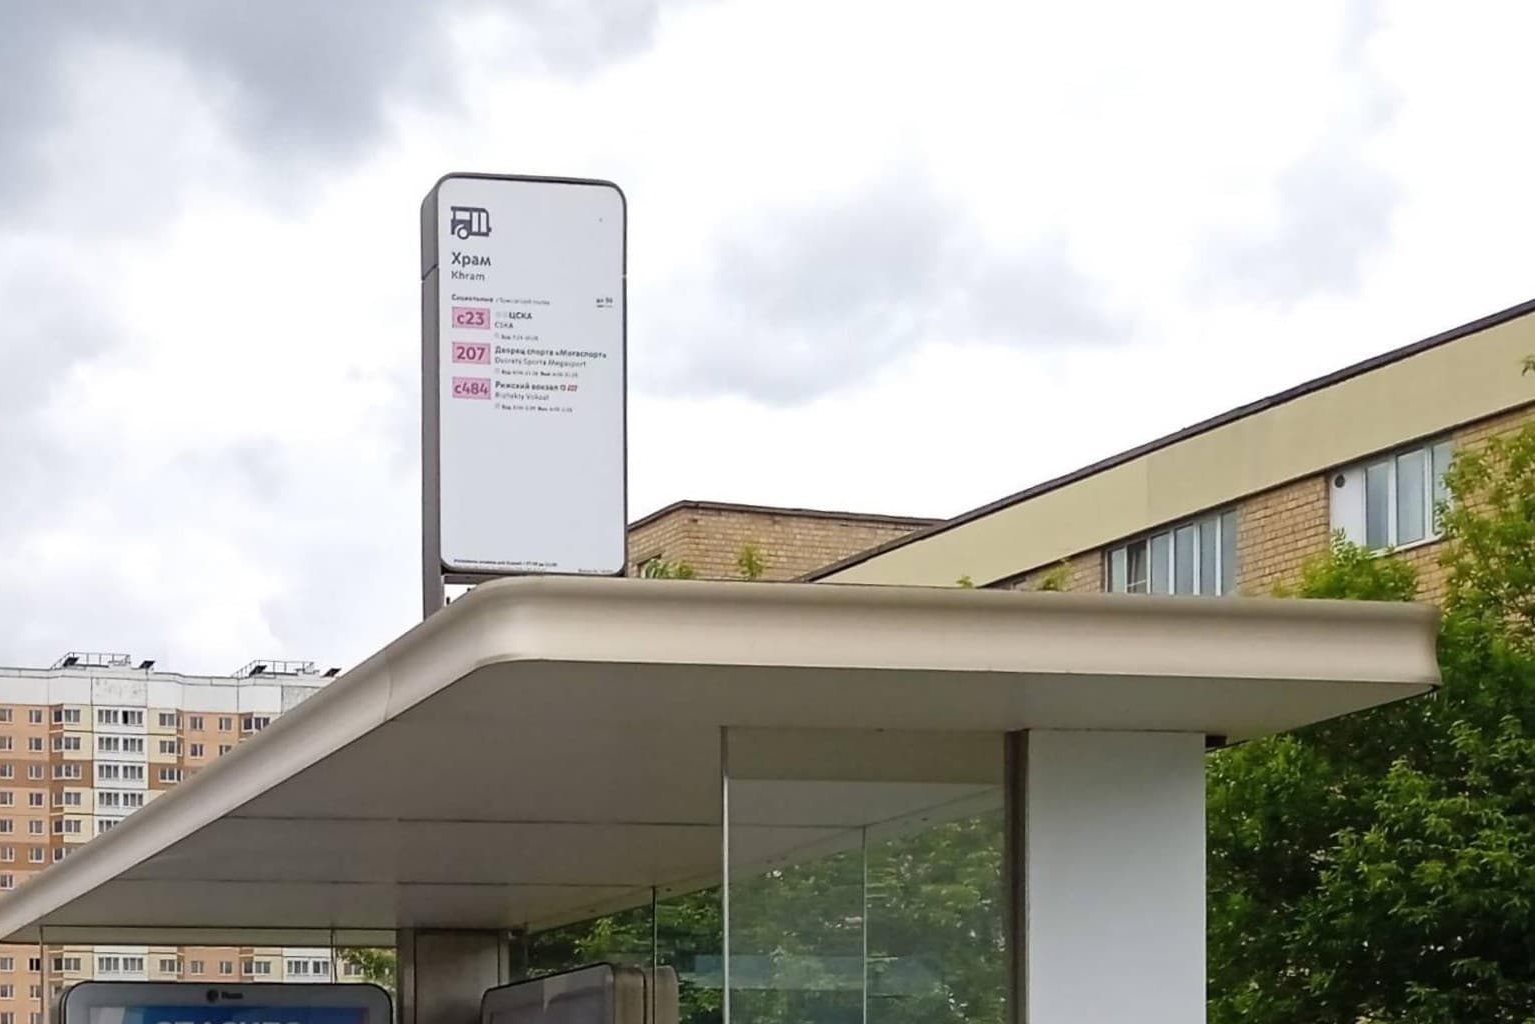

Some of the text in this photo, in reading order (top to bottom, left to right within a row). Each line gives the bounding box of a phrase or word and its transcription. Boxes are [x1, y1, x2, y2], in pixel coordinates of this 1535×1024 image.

[451, 252, 491, 268] Храм
[450, 270, 485, 282] Khram
[509, 311, 532, 320] ЦСКА
[456, 346, 485, 361] 207
